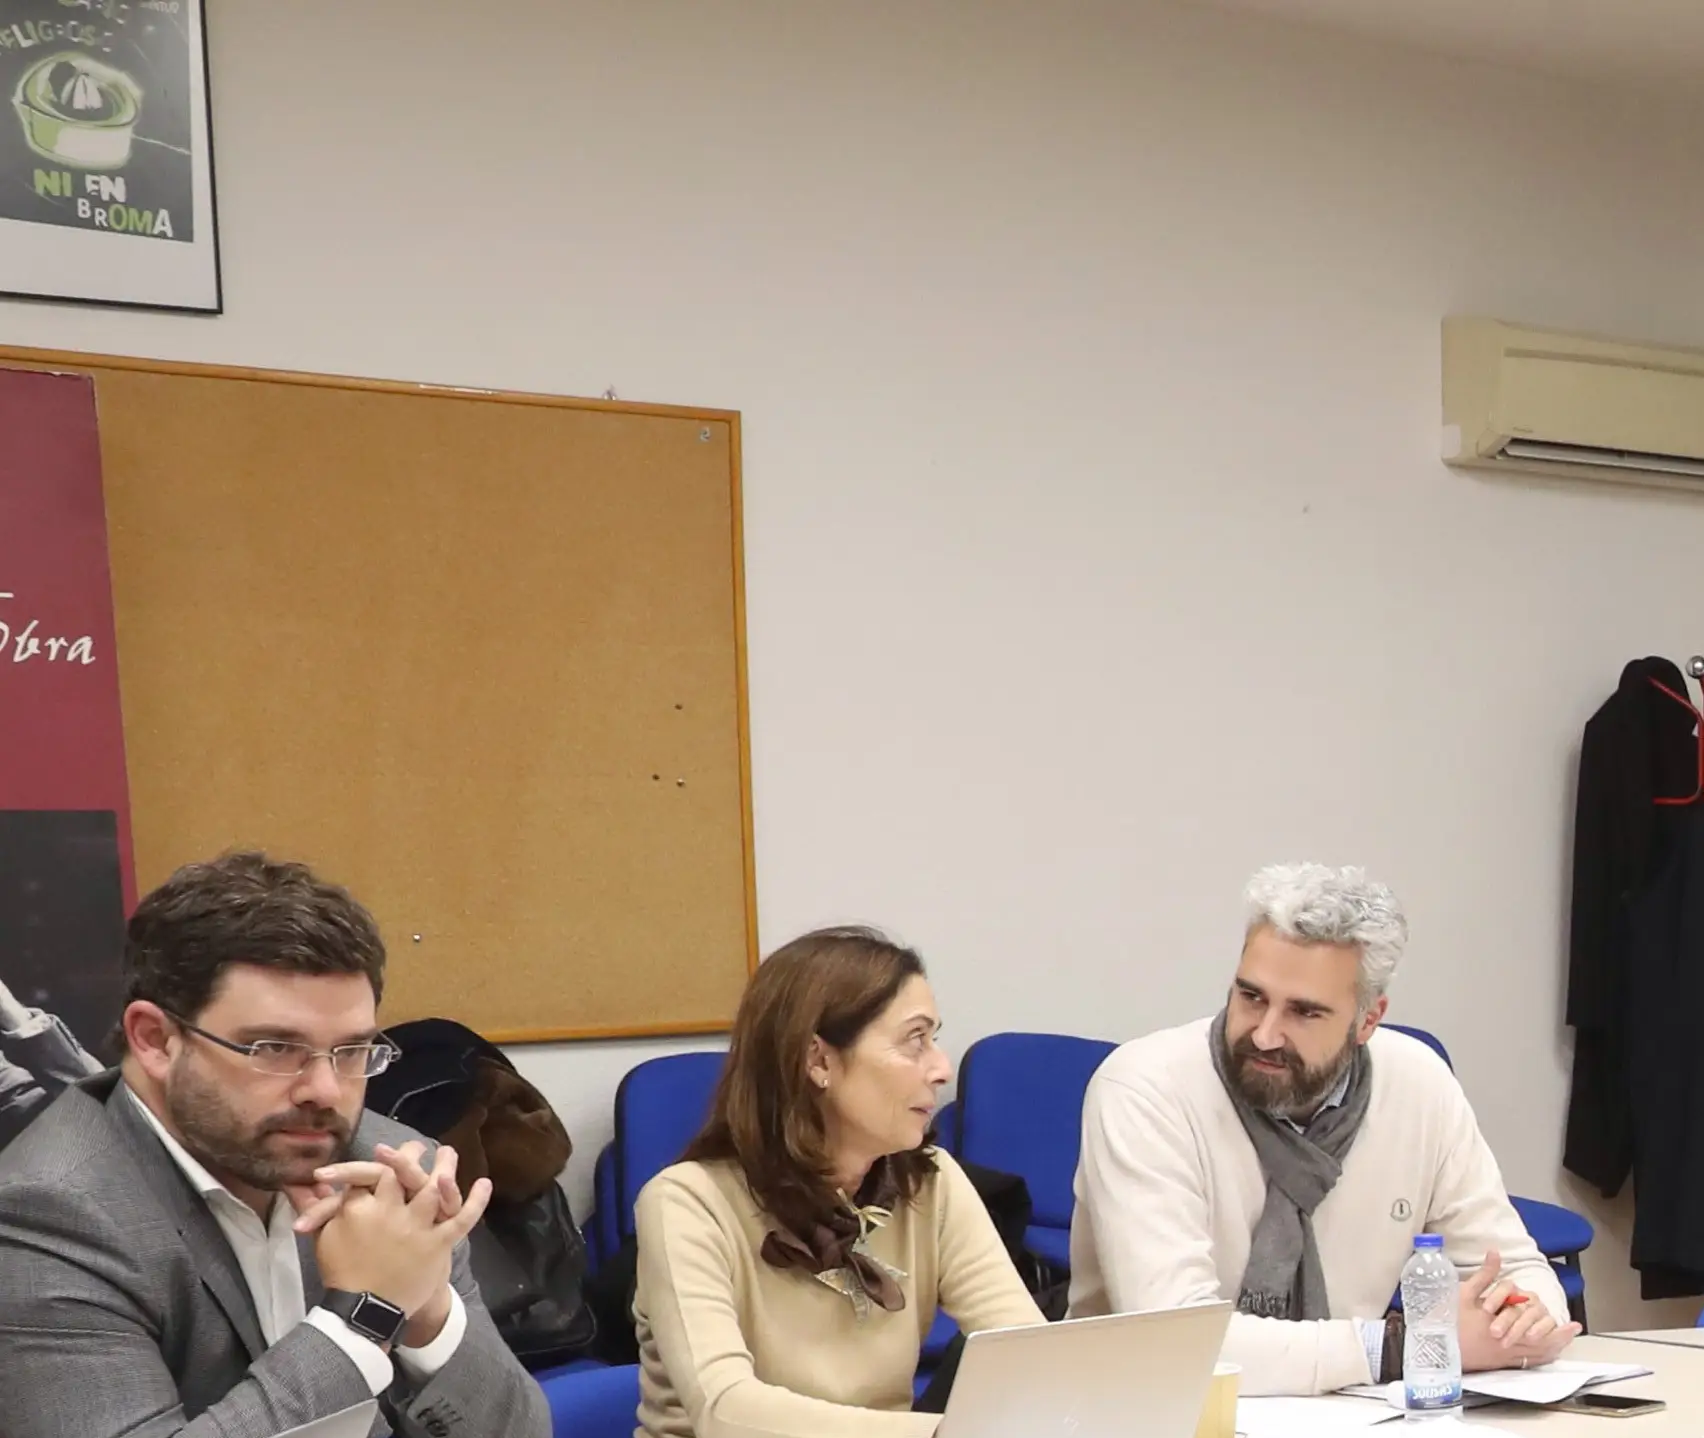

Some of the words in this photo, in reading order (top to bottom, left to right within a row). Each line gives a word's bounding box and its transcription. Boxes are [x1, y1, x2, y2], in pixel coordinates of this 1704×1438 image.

[33, 168, 73, 197] NI
[84, 173, 127, 203] EN
[77, 197, 174, 238] BROMA
